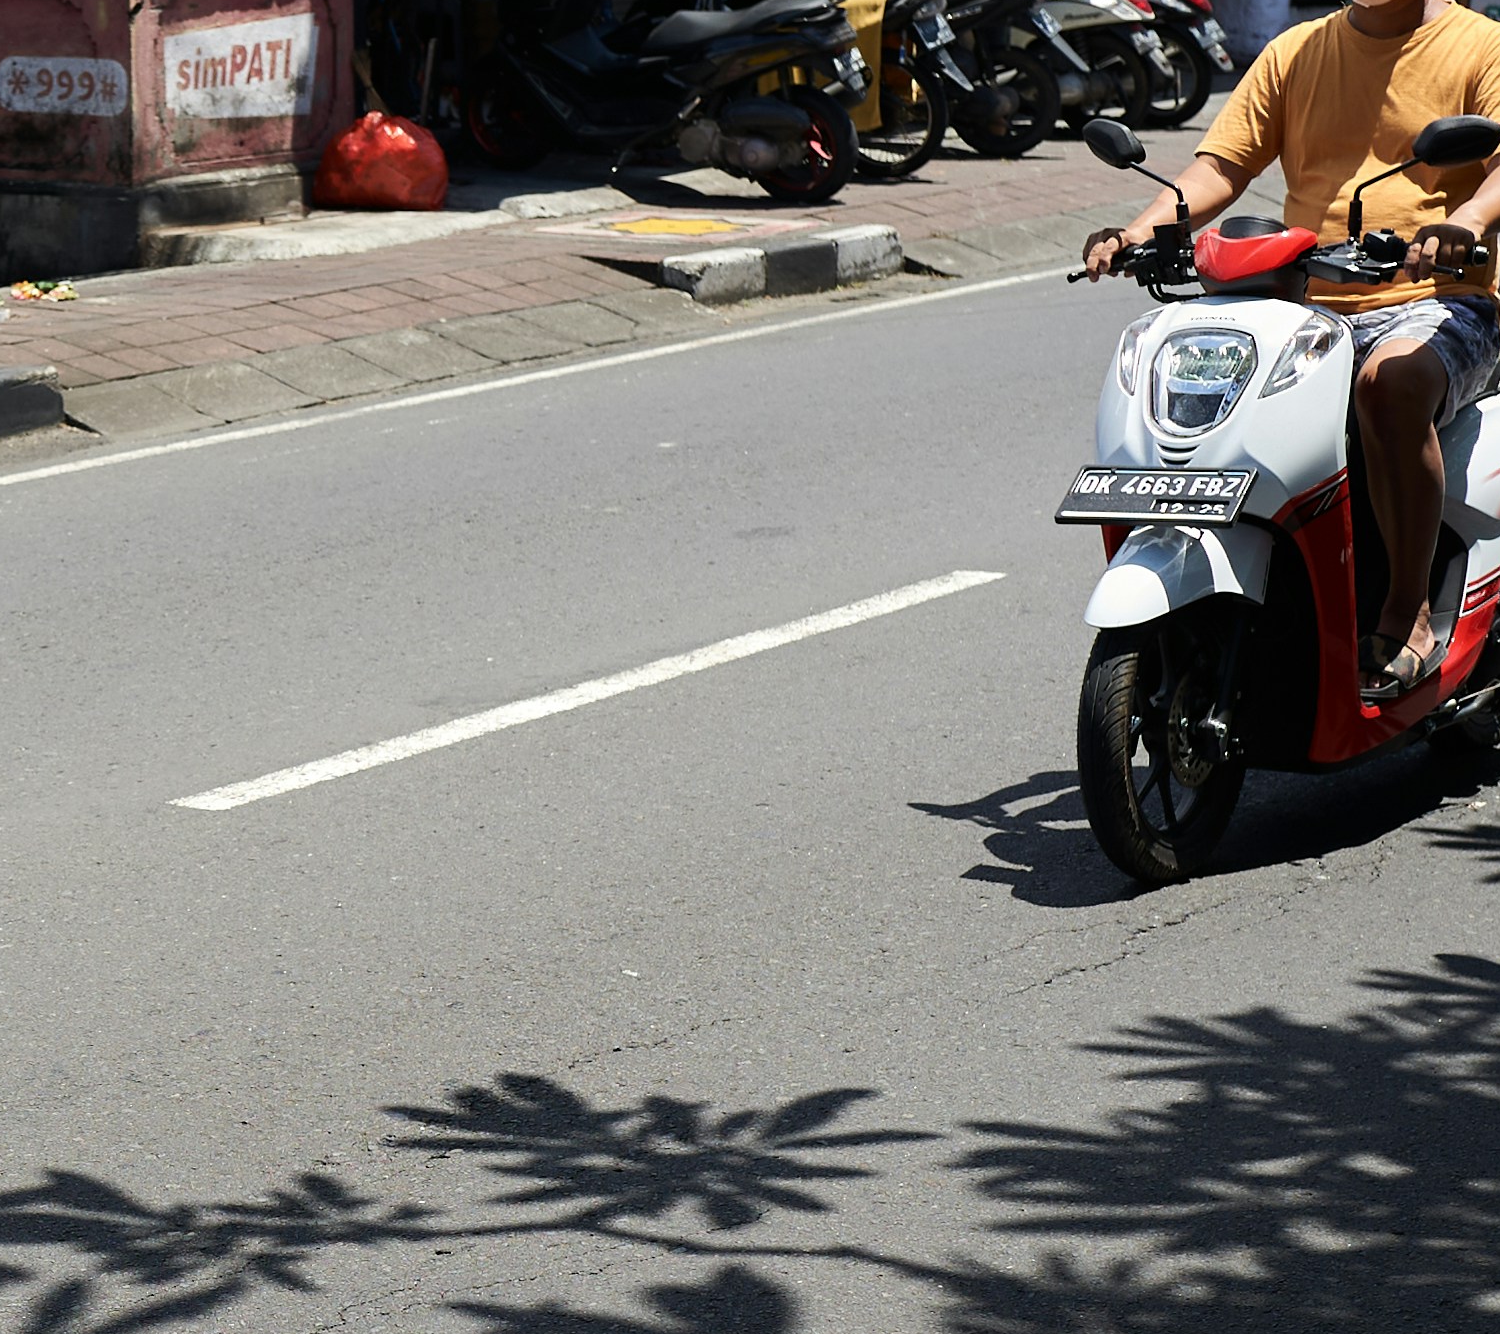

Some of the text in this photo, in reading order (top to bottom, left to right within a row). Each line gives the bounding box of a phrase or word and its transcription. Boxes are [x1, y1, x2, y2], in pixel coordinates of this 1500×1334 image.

[176, 38, 293, 91] simPATI
[1079, 474, 1242, 497] DK 4663 FBZ
